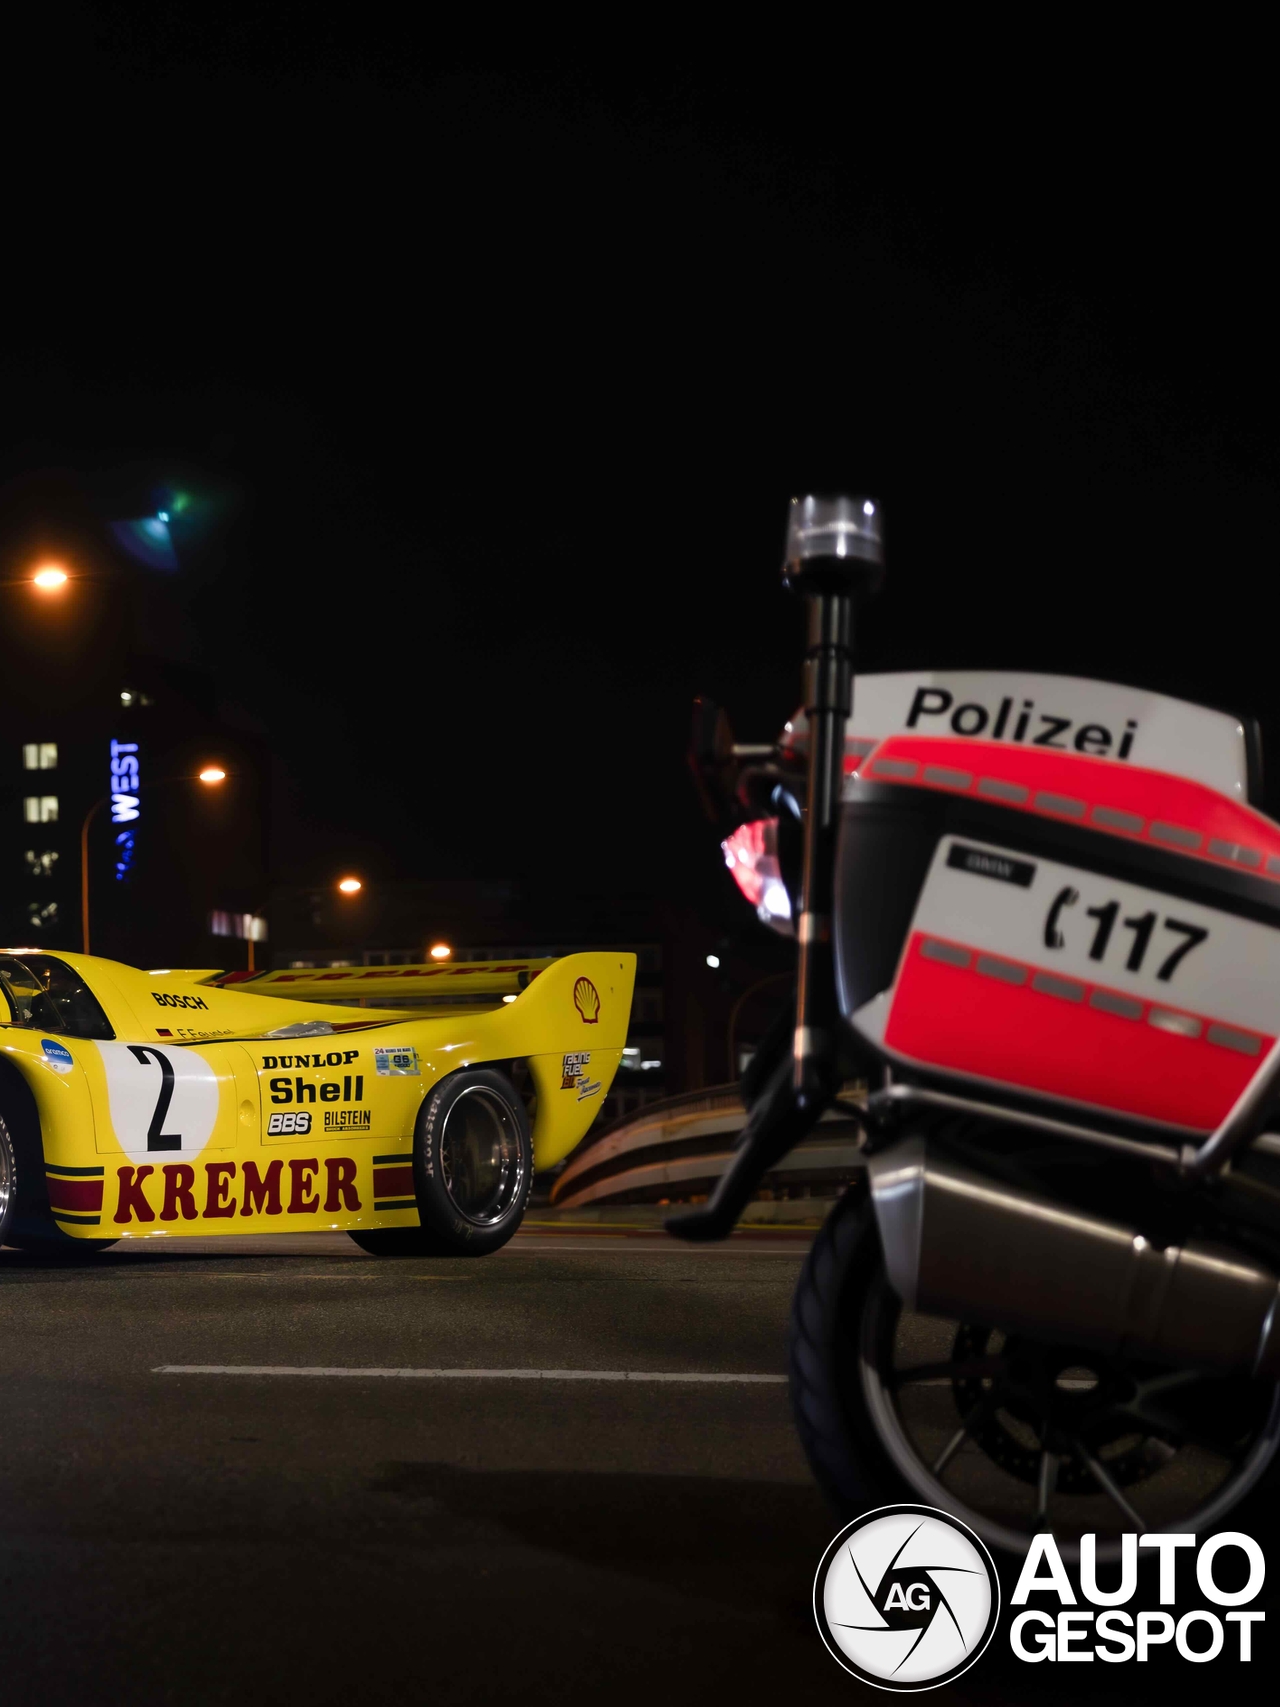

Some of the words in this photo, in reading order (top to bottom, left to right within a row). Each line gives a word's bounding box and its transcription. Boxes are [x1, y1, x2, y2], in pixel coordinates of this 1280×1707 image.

[905, 686, 1138, 760] Polizei
[110, 738, 140, 823] WEST
[1085, 900, 1209, 982] 117
[151, 992, 209, 1010] BOSCH
[262, 1050, 360, 1070] DUNLOP
[126, 1045, 183, 1152] 2
[270, 1075, 364, 1105] Shell
[267, 1111, 312, 1136] BBS
[324, 1110, 371, 1126] BILSTEIN
[114, 1157, 363, 1224] KREMER
